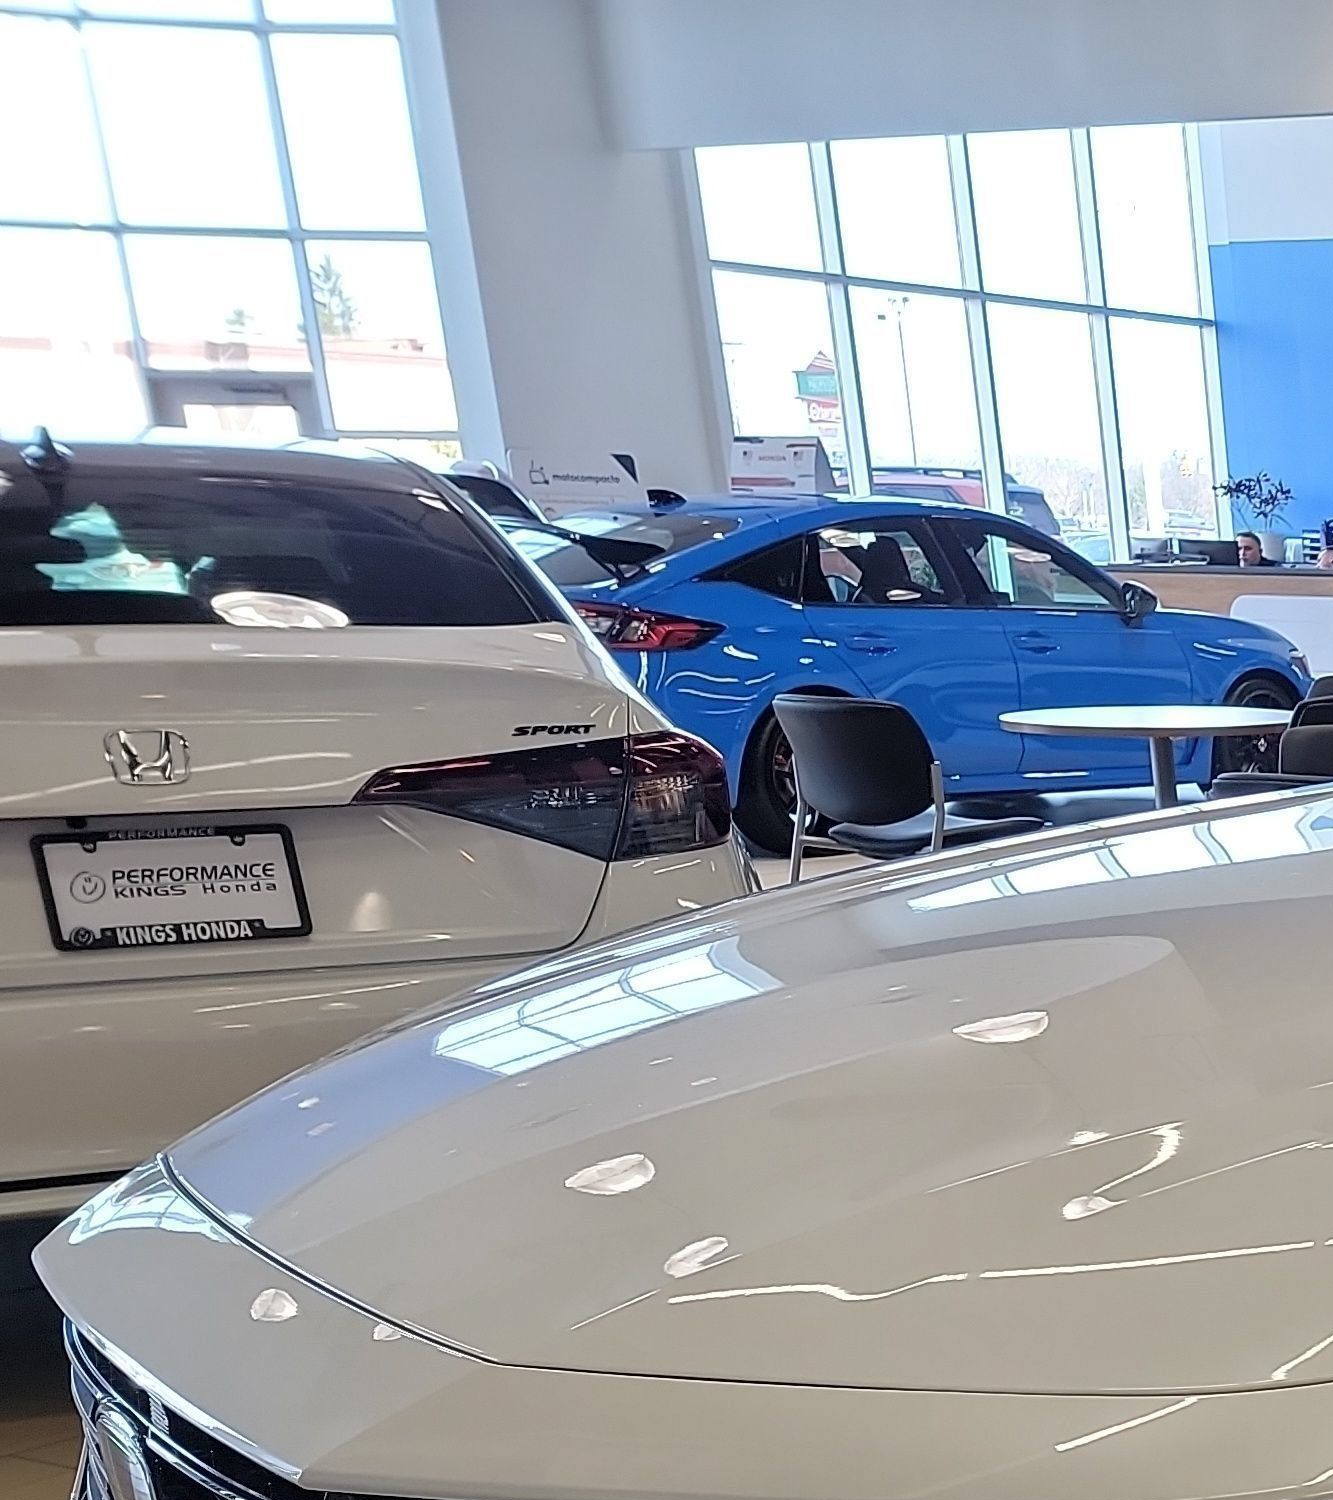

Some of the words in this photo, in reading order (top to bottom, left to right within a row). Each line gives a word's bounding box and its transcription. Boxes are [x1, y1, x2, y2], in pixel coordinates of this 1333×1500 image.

[511, 723, 597, 737] SPORT
[112, 863, 275, 885] PERFORMANCE
[113, 884, 188, 899] KINGS
[201, 880, 278, 895] Honda
[116, 923, 178, 946] KINGS
[181, 920, 254, 941] HONDA
